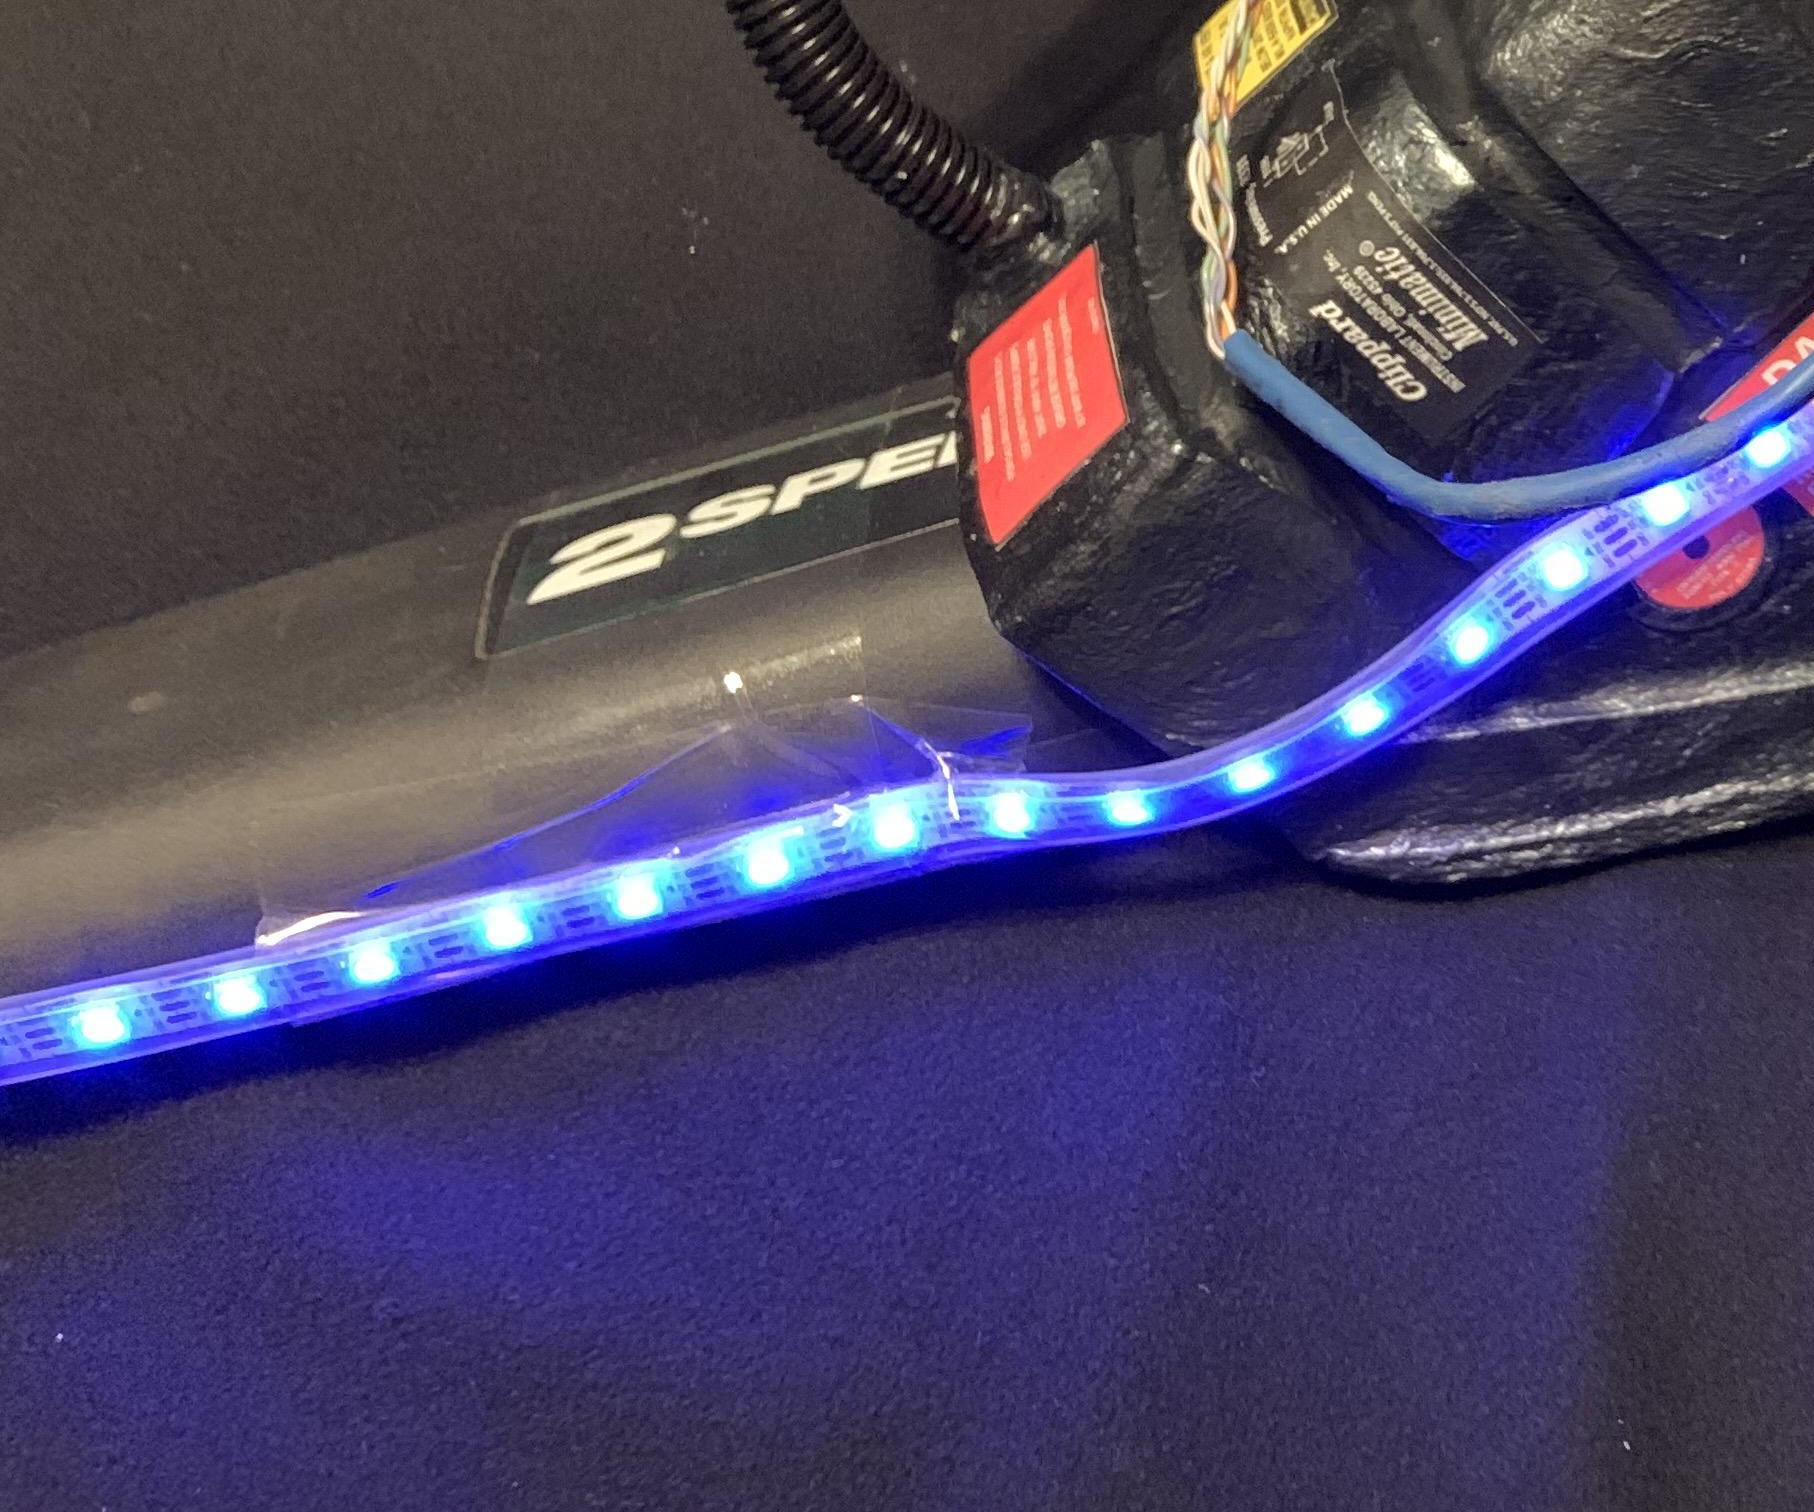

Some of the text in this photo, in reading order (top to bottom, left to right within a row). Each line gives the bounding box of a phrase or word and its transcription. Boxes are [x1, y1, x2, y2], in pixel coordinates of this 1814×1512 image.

[1306, 213, 1321, 228] IN
[1318, 184, 1353, 217] MADE
[1374, 247, 1489, 352] Minimatic
[1308, 300, 1428, 401] Clippard
[525, 513, 677, 606] 2
